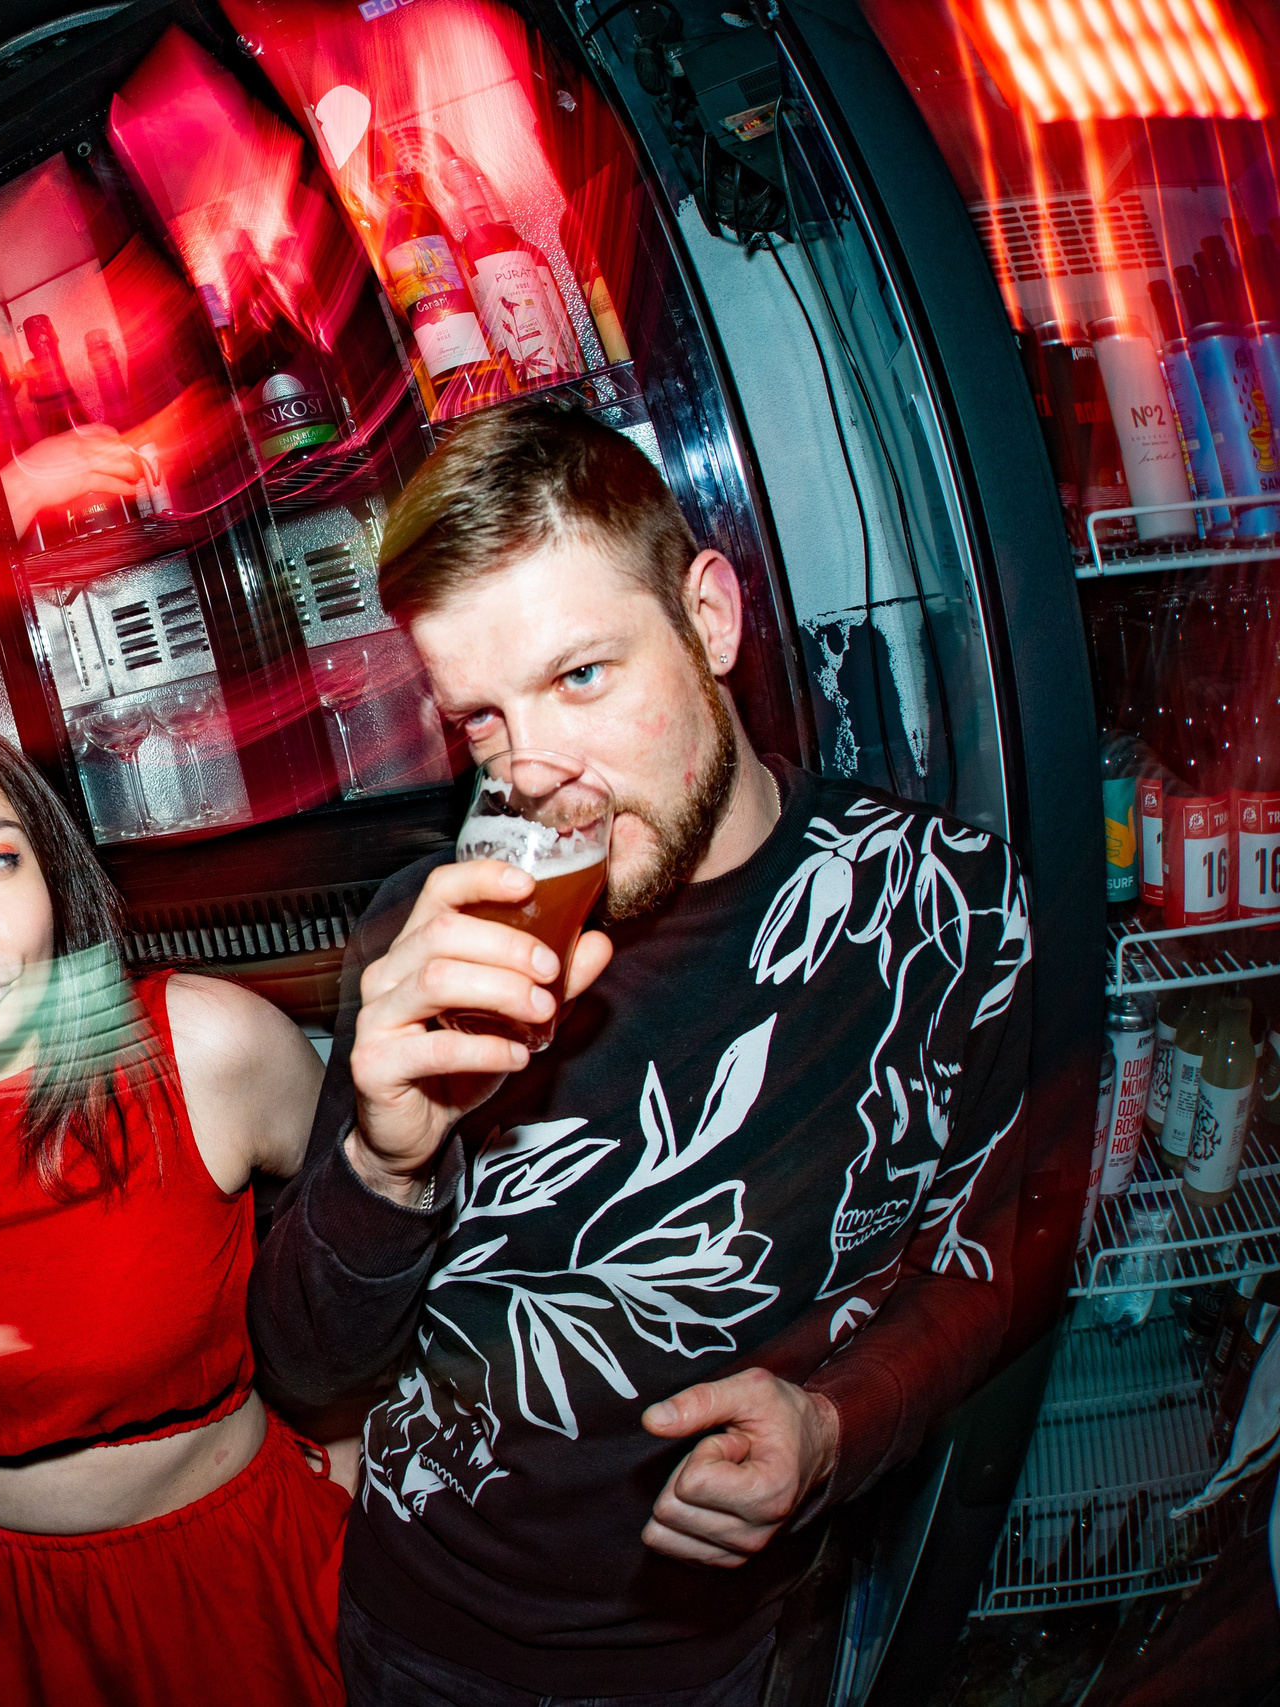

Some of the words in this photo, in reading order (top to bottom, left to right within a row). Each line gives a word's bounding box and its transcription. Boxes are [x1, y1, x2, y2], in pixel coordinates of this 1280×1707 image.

[416, 294, 449, 313] Canapi
[1106, 875, 1134, 890] SURF
[1202, 847, 1228, 898] 16
[1124, 1055, 1150, 1080] ОДИН
